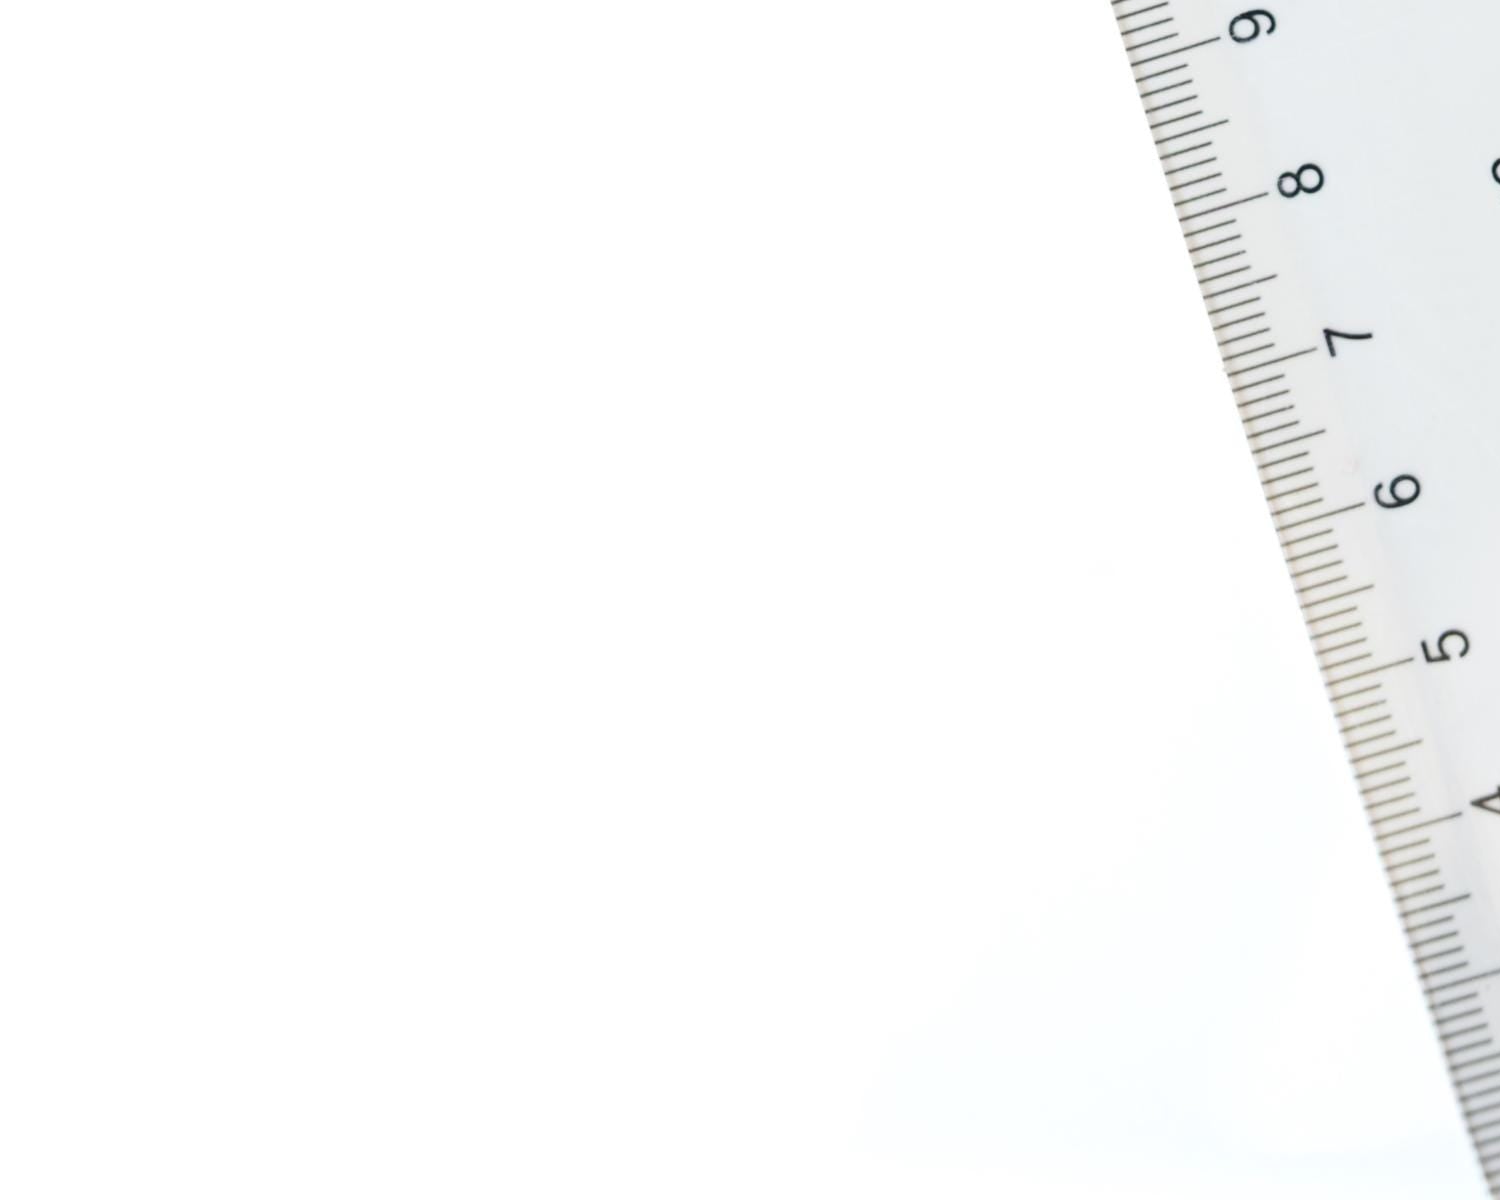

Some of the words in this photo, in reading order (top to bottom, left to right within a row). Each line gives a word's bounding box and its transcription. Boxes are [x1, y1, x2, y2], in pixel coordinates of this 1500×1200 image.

[1228, 8, 1277, 44] 9
[1276, 163, 1325, 199] 8
[1322, 327, 1373, 358] 7
[1373, 473, 1422, 510] 6
[1420, 628, 1470, 664] 5
